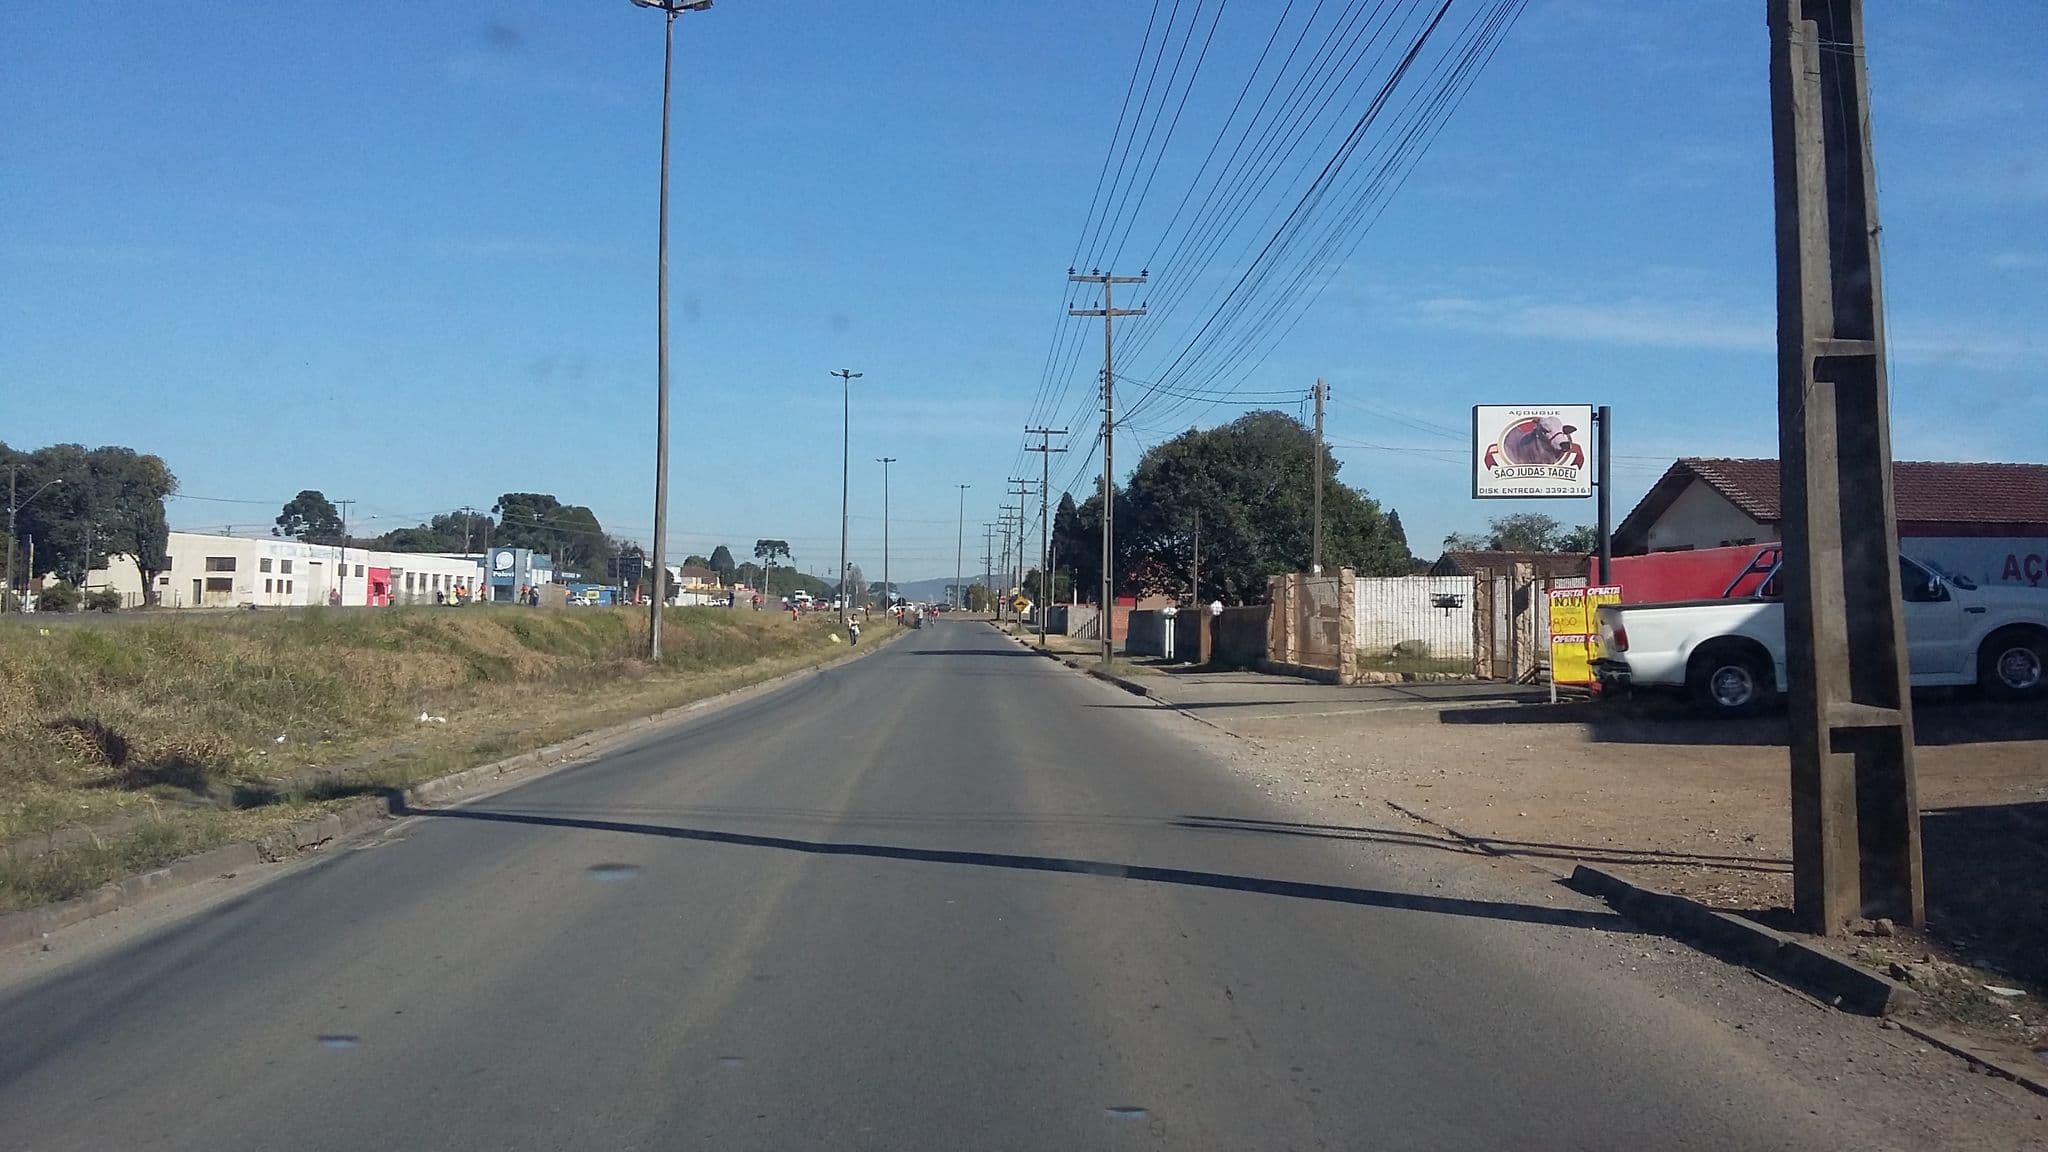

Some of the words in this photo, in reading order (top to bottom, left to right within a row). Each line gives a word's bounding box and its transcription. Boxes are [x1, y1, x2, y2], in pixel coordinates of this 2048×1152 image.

[1517, 467, 1545, 477] JUDAS
[1548, 467, 1577, 479] TADEU
[2002, 553, 2048, 587] AÇ
